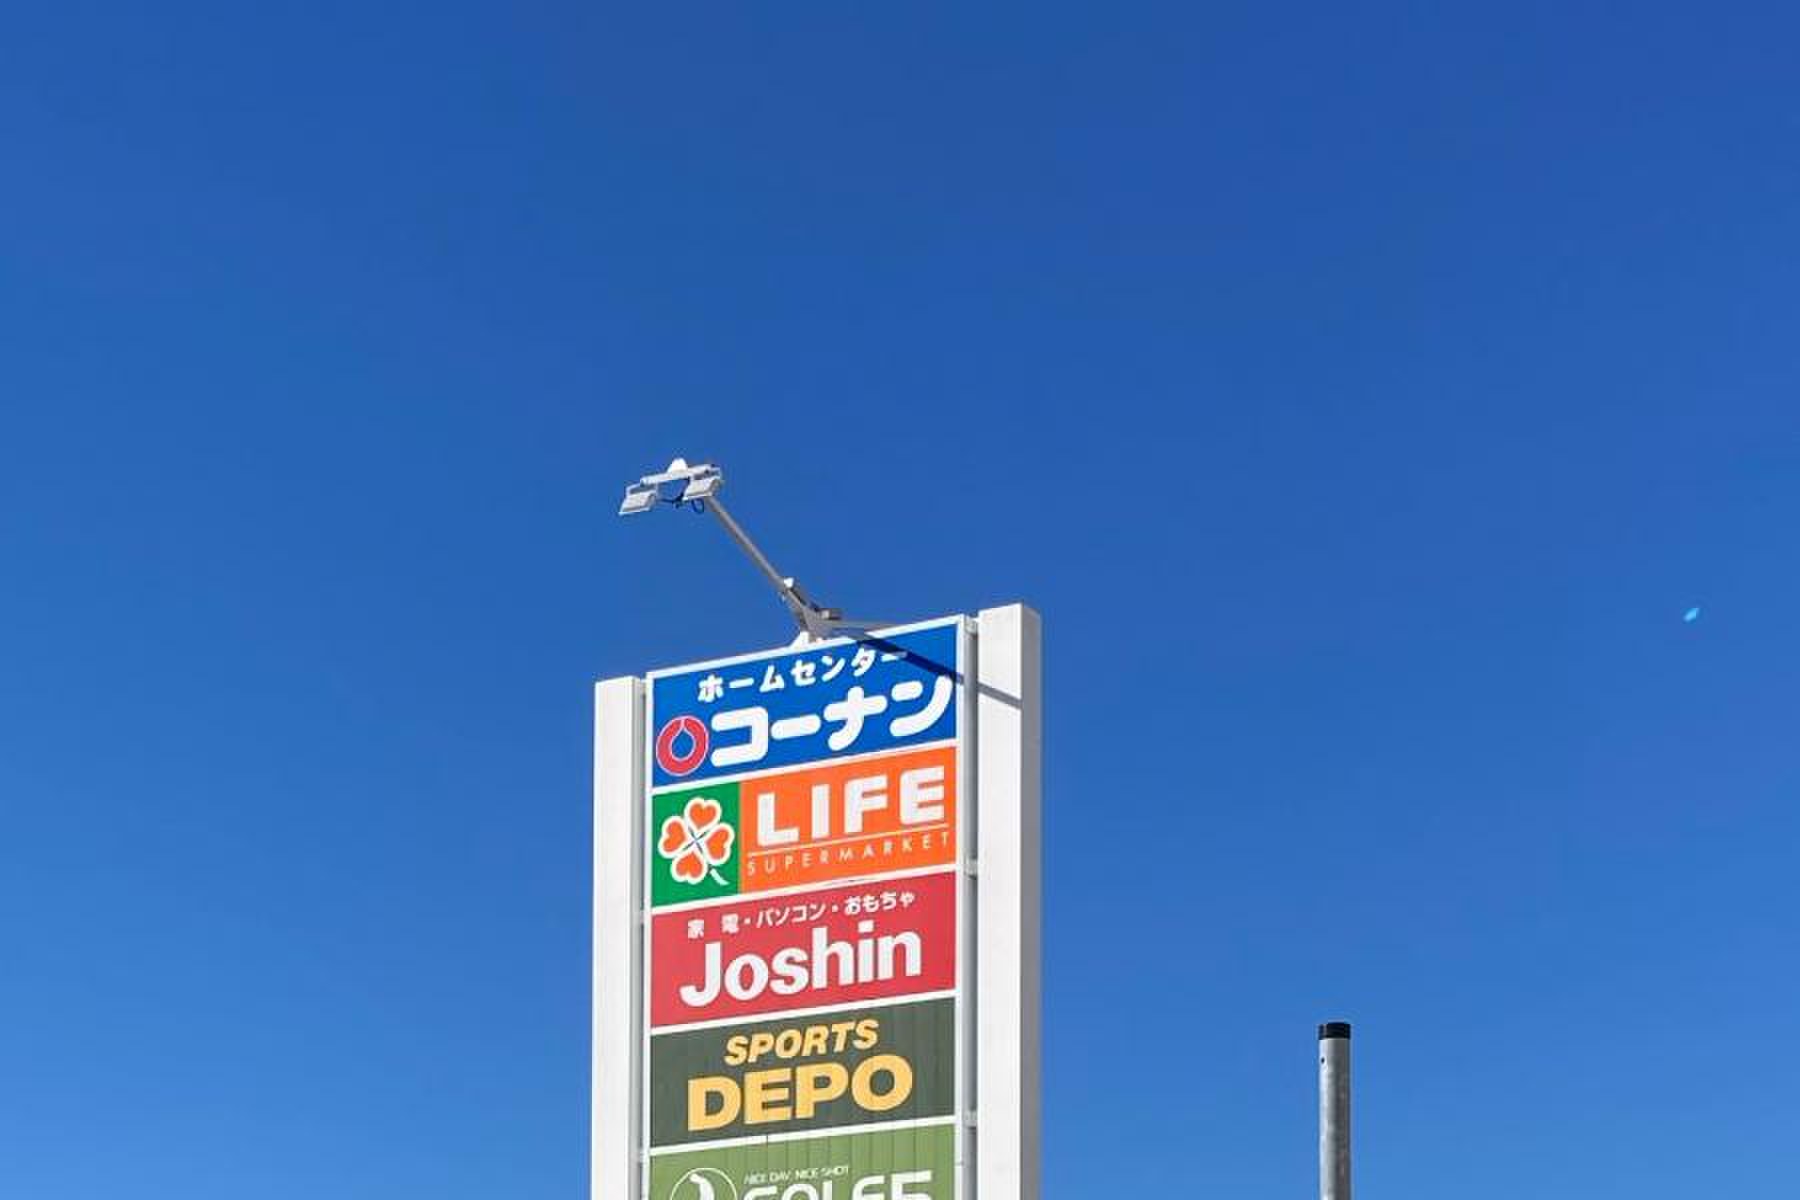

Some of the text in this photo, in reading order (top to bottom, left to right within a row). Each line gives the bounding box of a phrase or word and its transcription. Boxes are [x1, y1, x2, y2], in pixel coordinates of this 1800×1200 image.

[698, 648, 908, 702] ホームセンター
[711, 675, 952, 767] コーナン
[757, 766, 945, 847] LIFE
[747, 831, 949, 876] SUPERMARKET
[679, 919, 921, 1007] Joshin
[724, 1019, 880, 1066] SPORTS
[687, 1054, 913, 1132] DEPO
